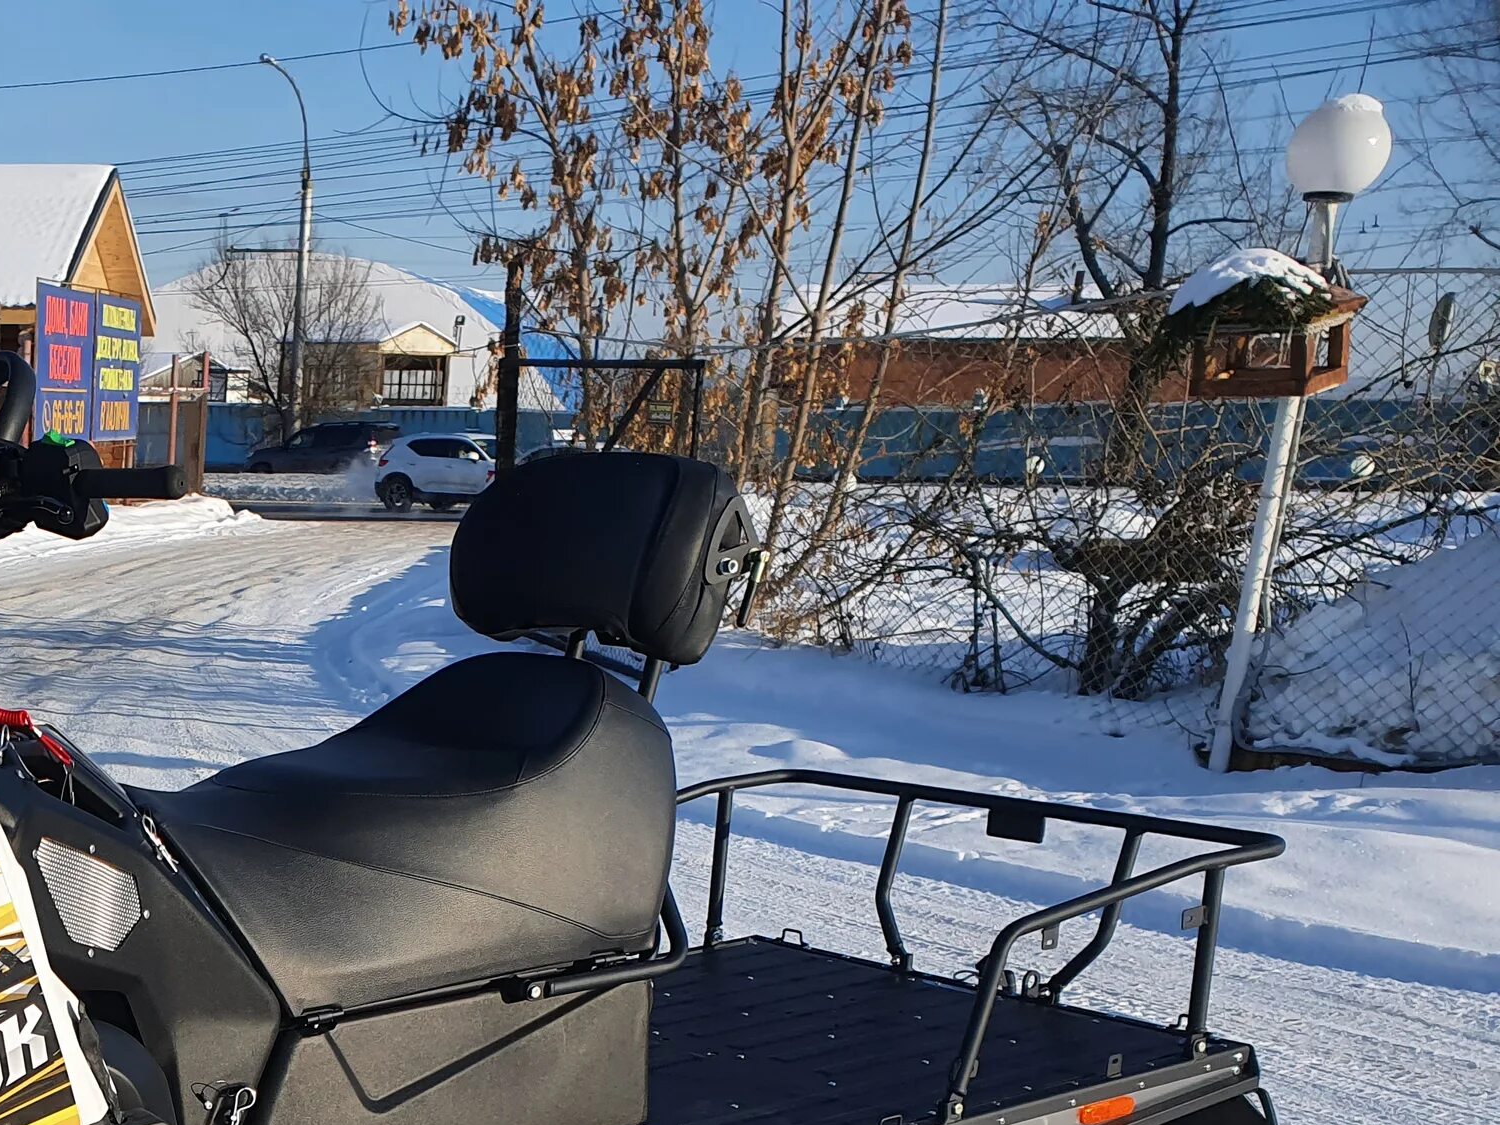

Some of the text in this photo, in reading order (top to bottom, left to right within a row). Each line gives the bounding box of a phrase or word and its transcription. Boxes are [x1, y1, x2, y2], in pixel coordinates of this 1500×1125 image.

[70, 301, 88, 336] БАНИ
[49, 343, 81, 383] БЕСЕДКИ
[52, 400, 84, 434] 66-66-50
